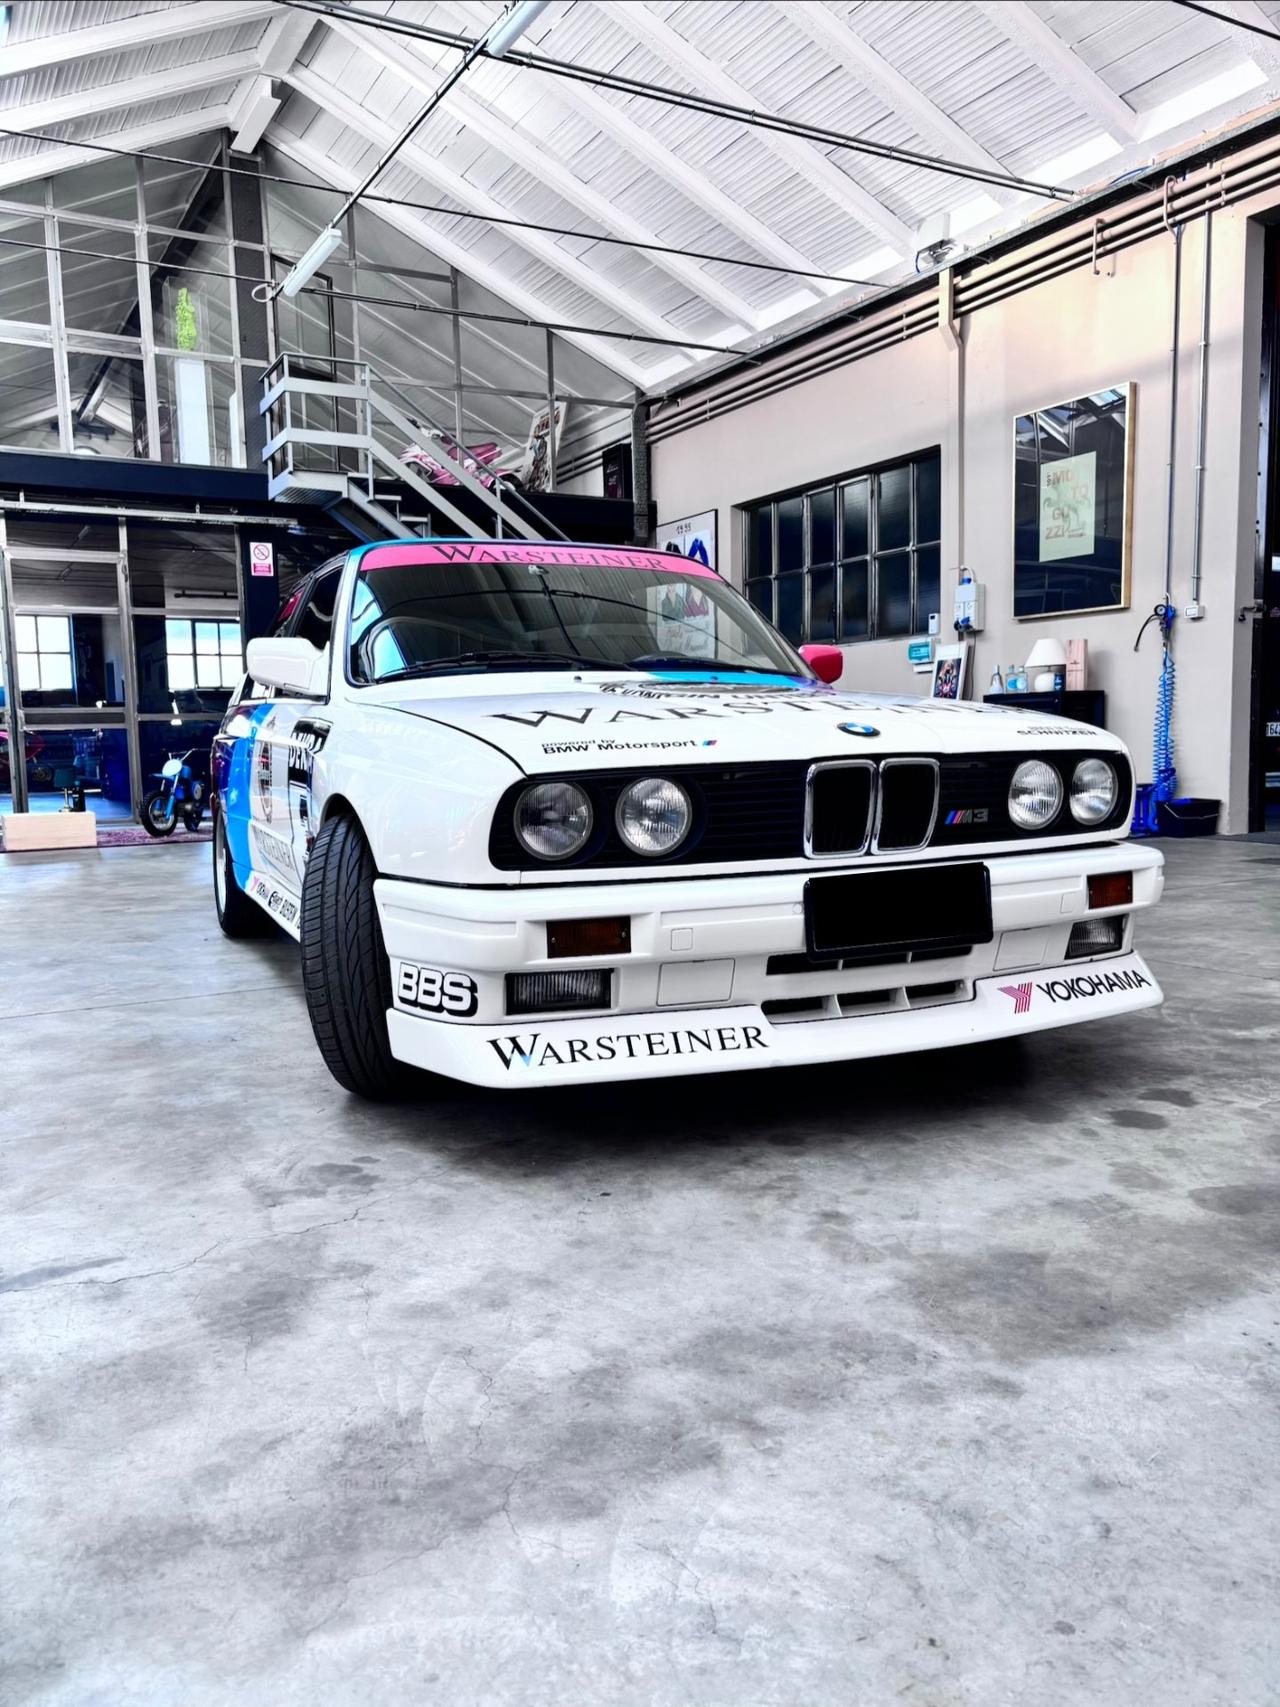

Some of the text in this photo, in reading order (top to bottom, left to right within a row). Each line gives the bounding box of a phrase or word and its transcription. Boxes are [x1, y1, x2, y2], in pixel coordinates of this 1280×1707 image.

[432, 545, 668, 570] WARSTEINER
[542, 738, 616, 749] powered by
[543, 738, 697, 755] BMW Motorsport
[399, 962, 477, 1016] BBS
[1036, 969, 1152, 1003] YOKOHAMA
[487, 1026, 770, 1070] WARSTEINER
